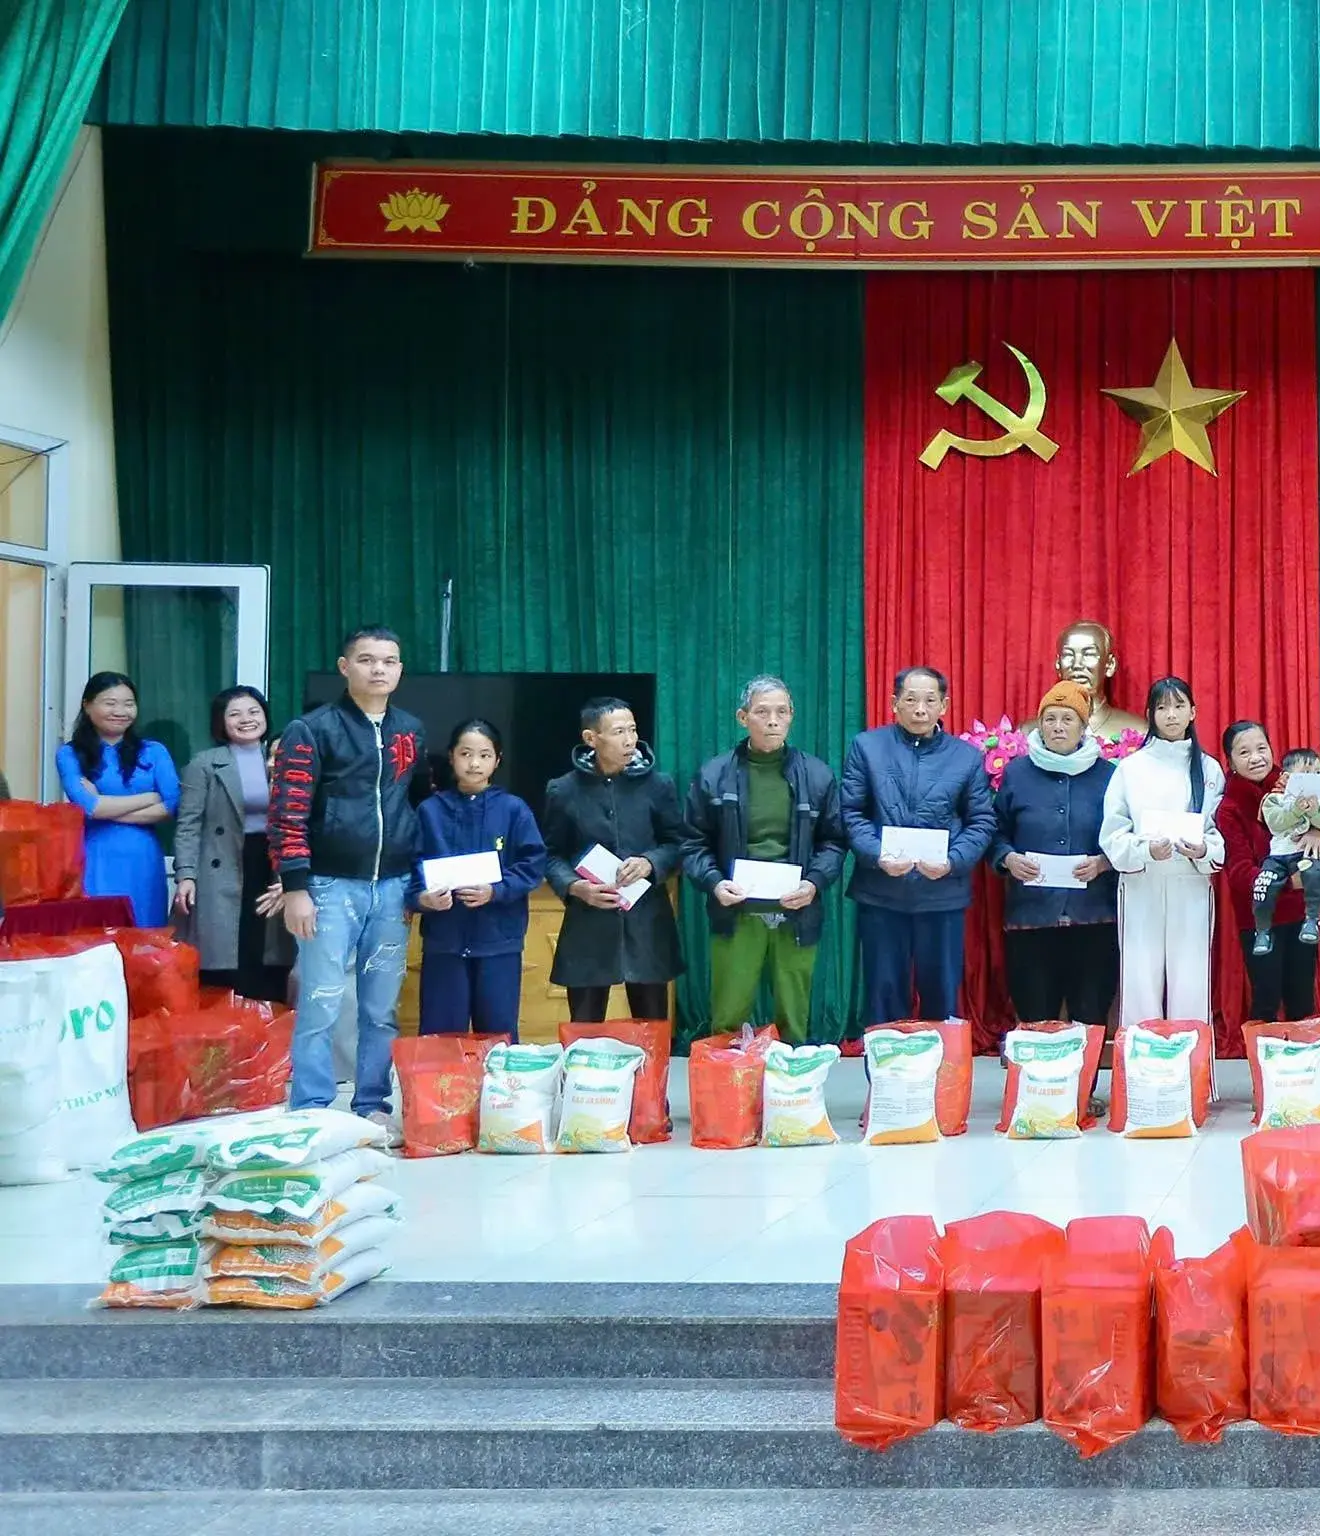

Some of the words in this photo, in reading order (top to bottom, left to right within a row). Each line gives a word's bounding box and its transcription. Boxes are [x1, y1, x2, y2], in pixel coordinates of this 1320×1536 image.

[510, 180, 713, 238] ĐẢNG
[741, 187, 934, 252] CỘNG
[962, 183, 1102, 241] SẢN
[1131, 185, 1301, 249] VIỆT
